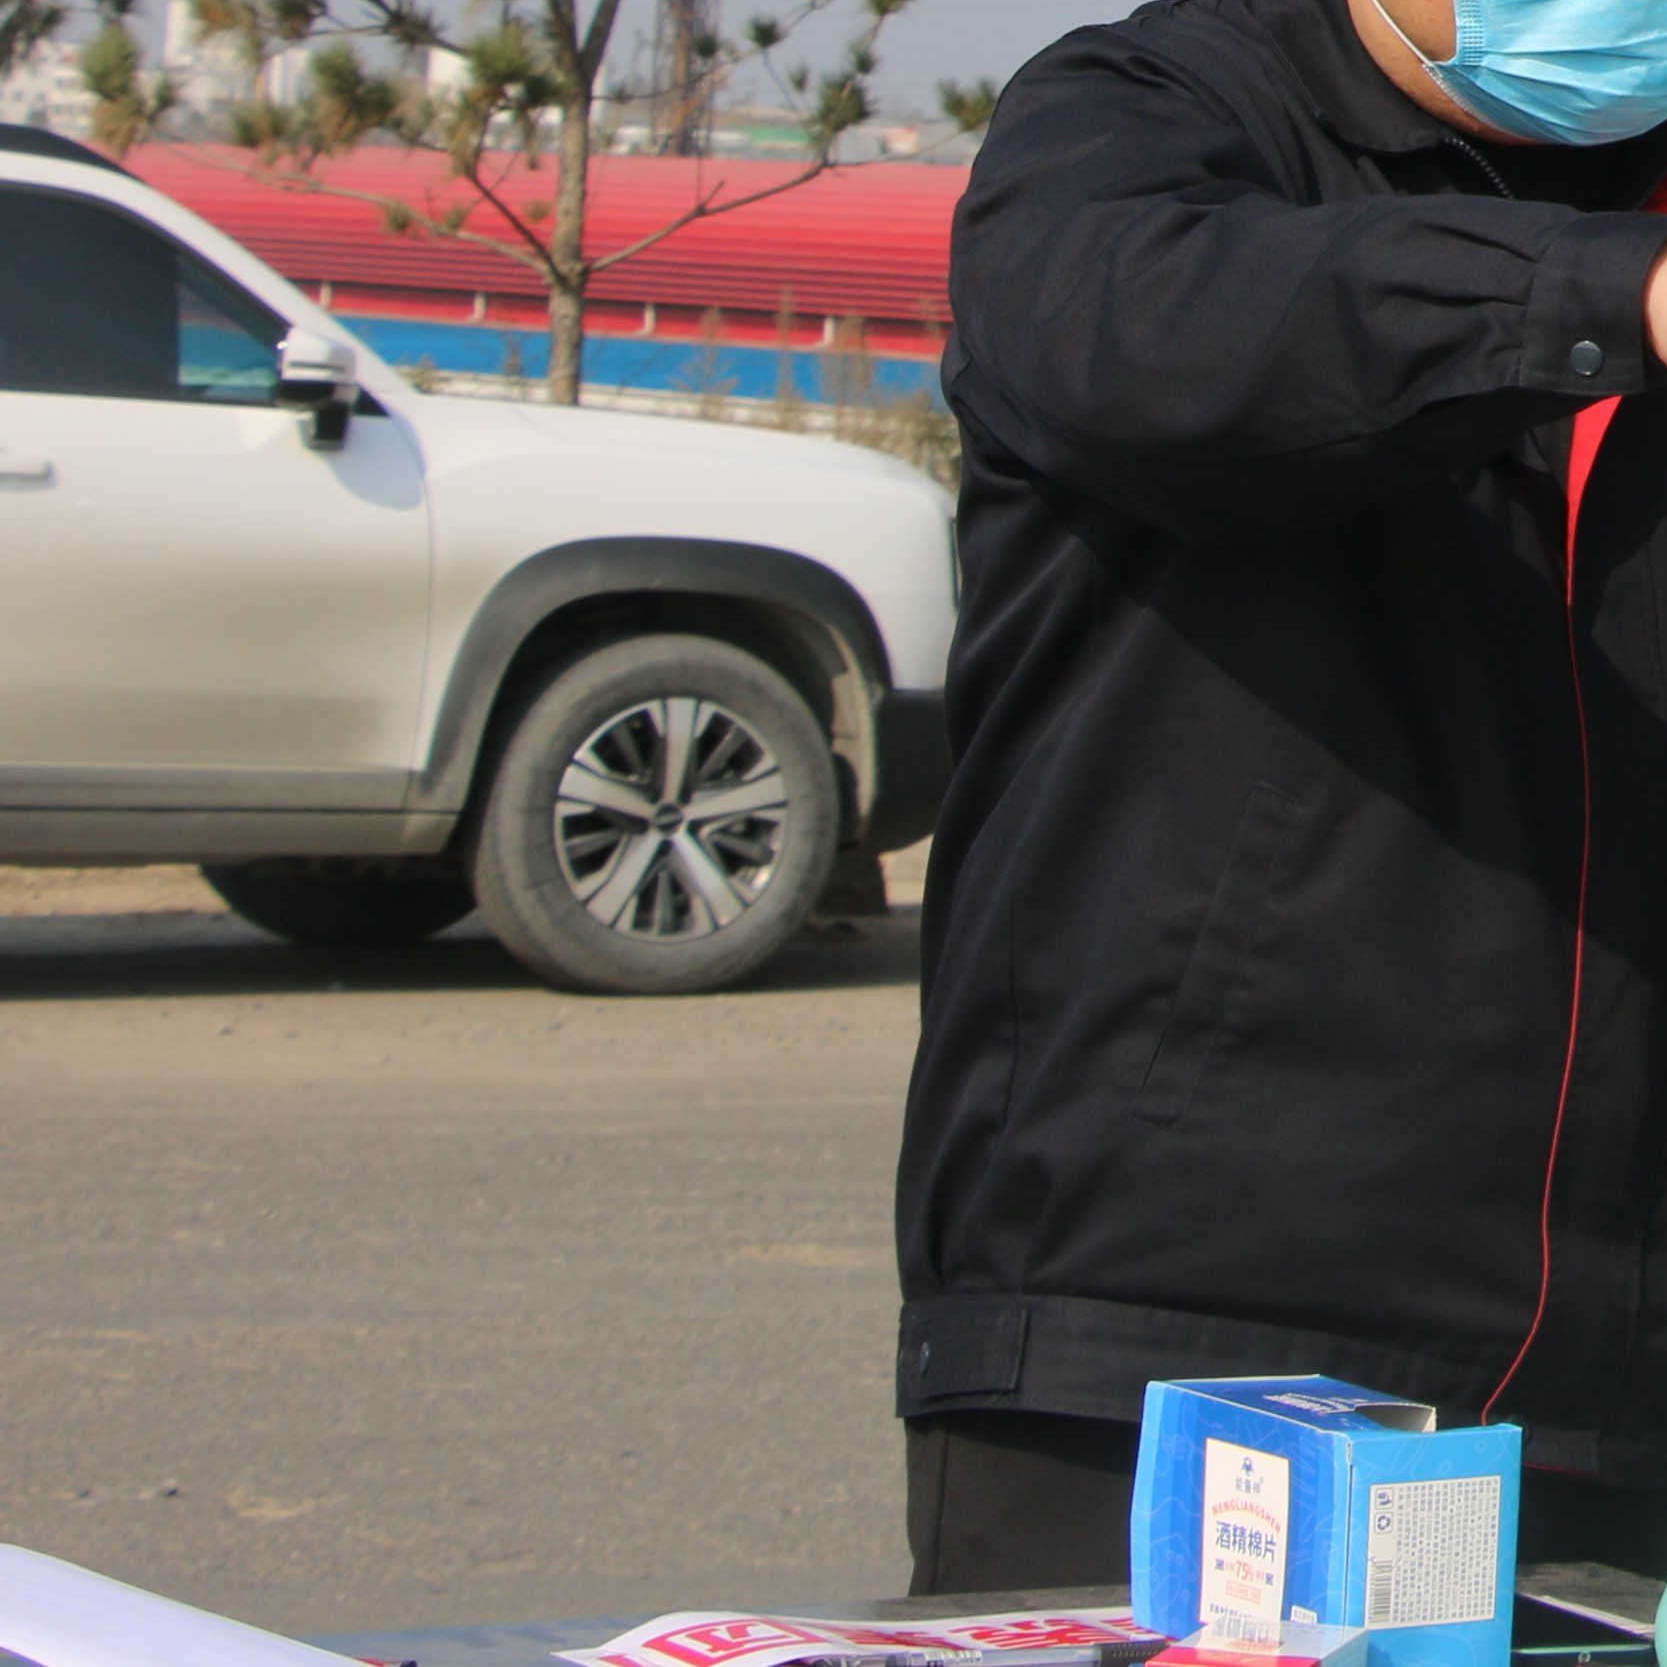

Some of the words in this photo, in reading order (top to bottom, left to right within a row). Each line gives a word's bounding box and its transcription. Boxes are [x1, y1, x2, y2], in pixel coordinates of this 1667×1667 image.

[1212, 1499, 1281, 1534] NENGLIANGSHEN
[1215, 1519, 1277, 1564] 酒精棉片
